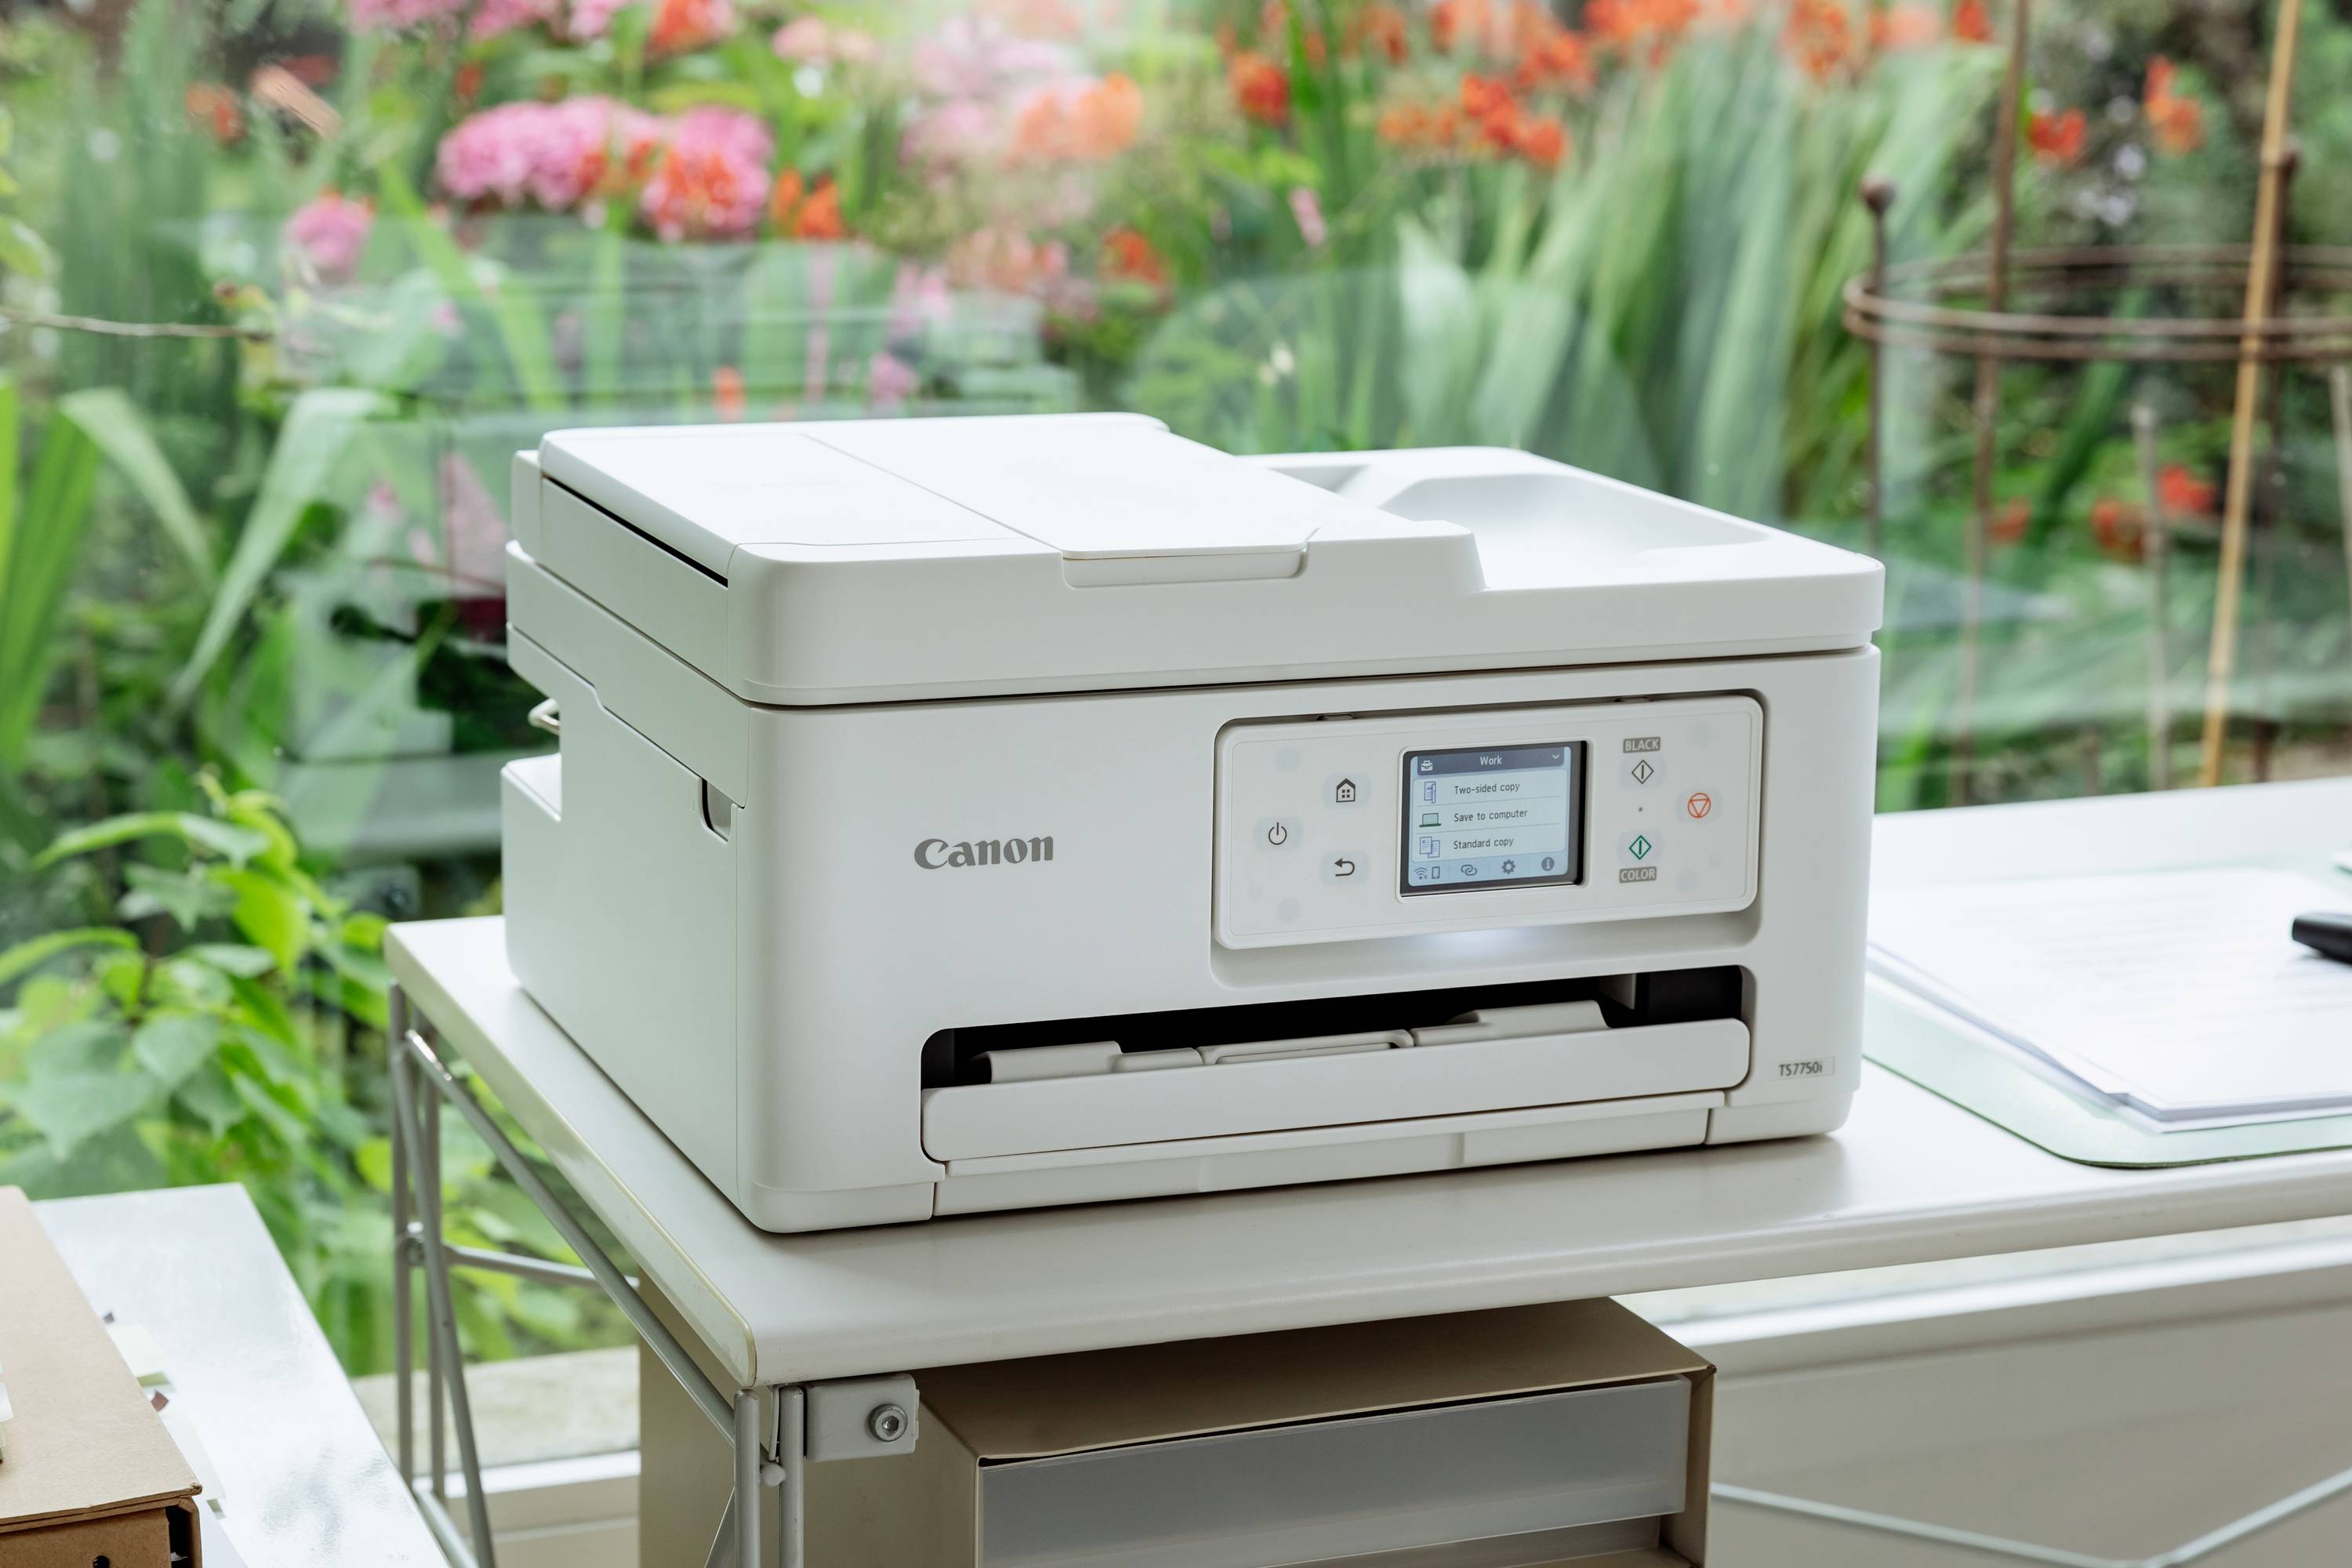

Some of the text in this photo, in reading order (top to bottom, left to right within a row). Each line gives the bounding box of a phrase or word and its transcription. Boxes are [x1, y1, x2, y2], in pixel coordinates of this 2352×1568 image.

[1625, 739, 1659, 751] BLACK
[1480, 756, 1502, 765] Work
[1454, 783, 1520, 794] Two-sided copy
[1454, 810, 1528, 822] Save to computer
[1454, 838, 1514, 849] Standard copy
[914, 836, 1054, 869] Canon
[1621, 868, 1655, 881] COLOR
[1779, 1061, 1823, 1076] TS7750i
